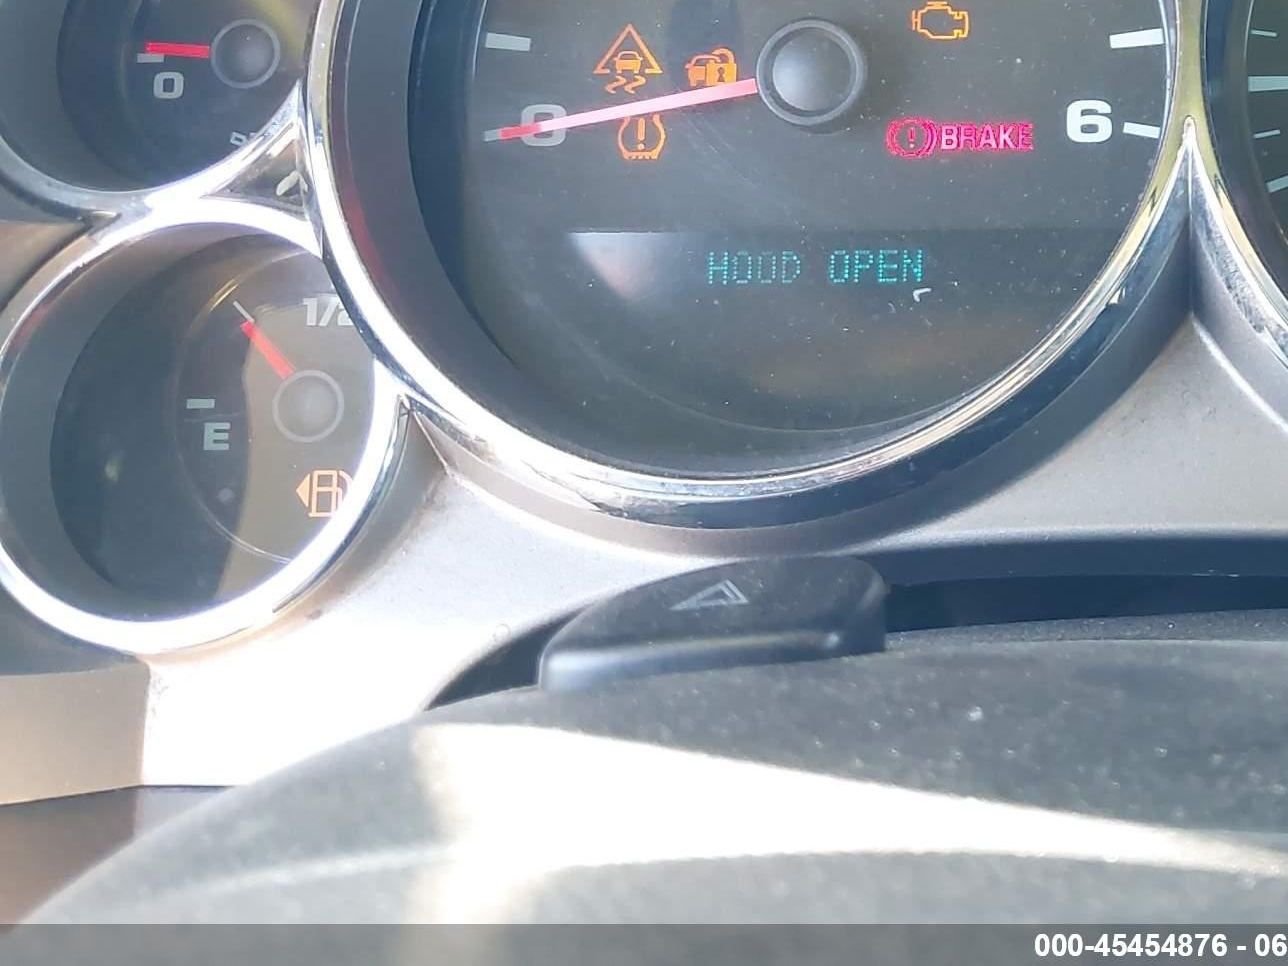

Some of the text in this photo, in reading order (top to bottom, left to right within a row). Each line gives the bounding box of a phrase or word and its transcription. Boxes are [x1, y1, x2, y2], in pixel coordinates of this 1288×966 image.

[153, 71, 184, 99] 0
[521, 104, 567, 146] 0
[938, 121, 1034, 151] BRAKE
[1066, 100, 1112, 142] 6
[829, 250, 922, 283] OPEN
[203, 422, 231, 450] E
